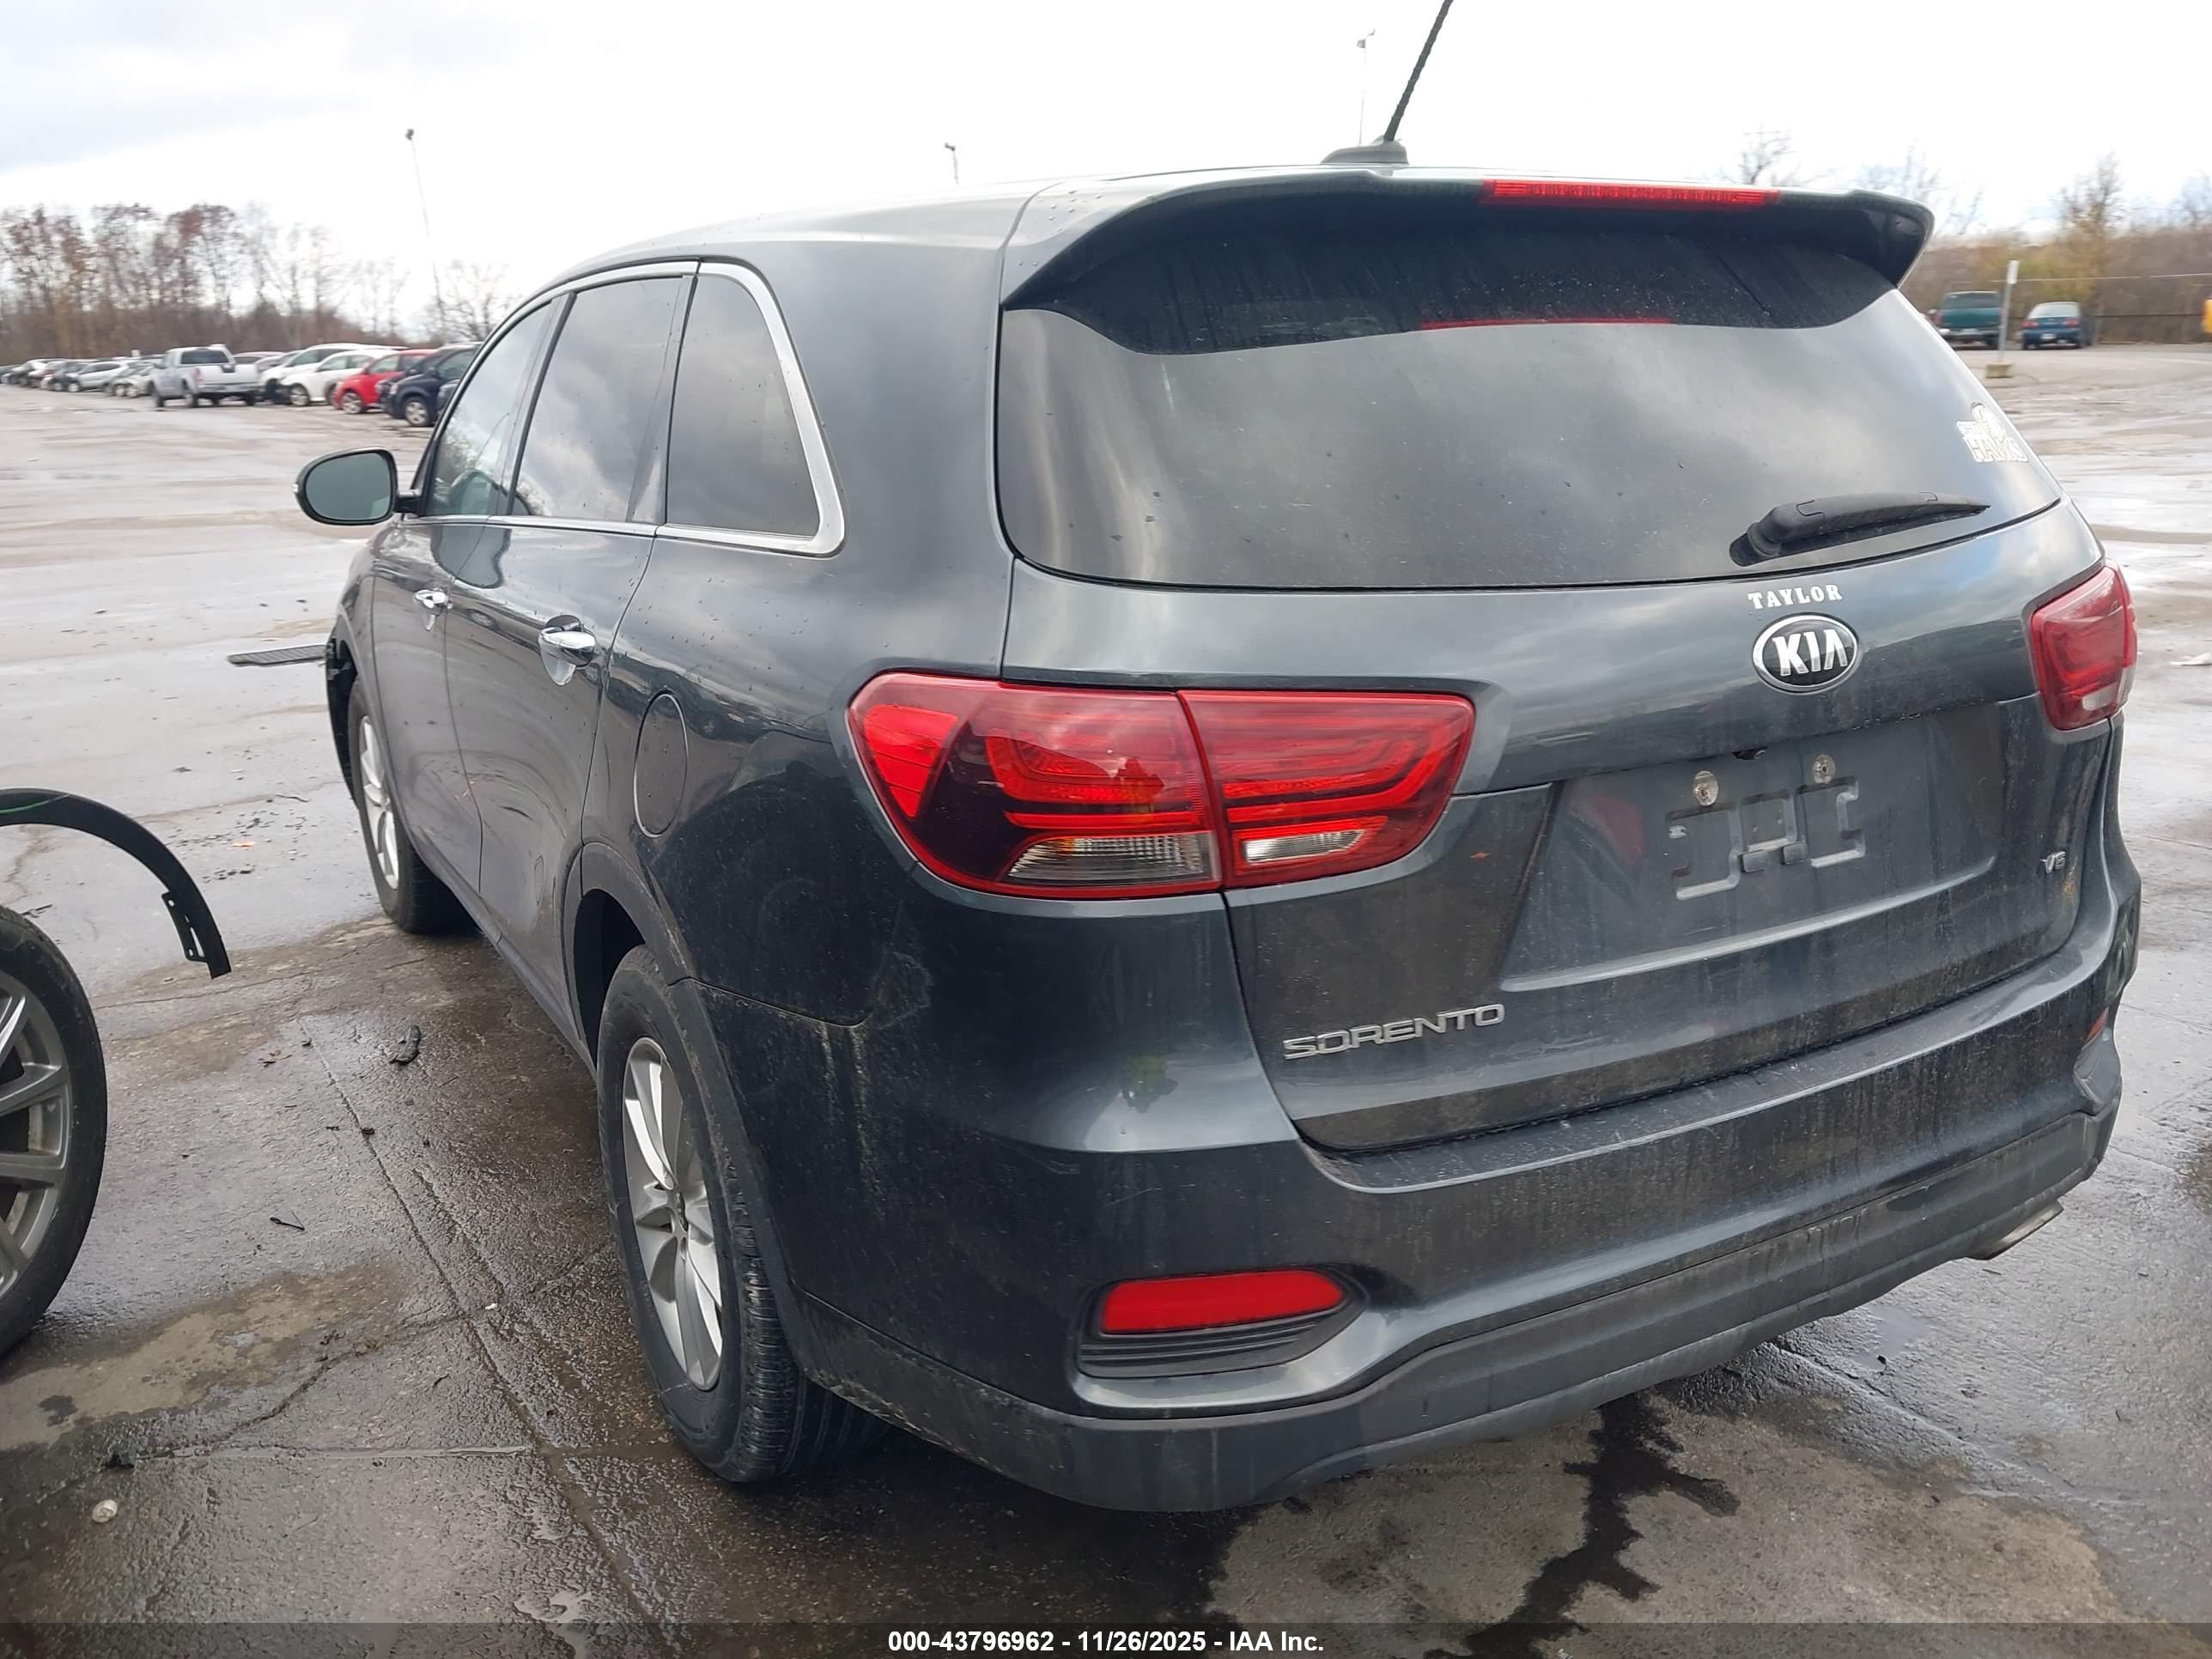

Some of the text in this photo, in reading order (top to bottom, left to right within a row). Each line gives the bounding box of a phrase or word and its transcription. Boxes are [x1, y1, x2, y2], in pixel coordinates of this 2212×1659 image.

[1747, 584, 1843, 610] TAYLOR
[1771, 629, 1848, 677] KIA
[2040, 851, 2066, 874] V6
[1284, 1003, 1505, 1060] SORENTO
